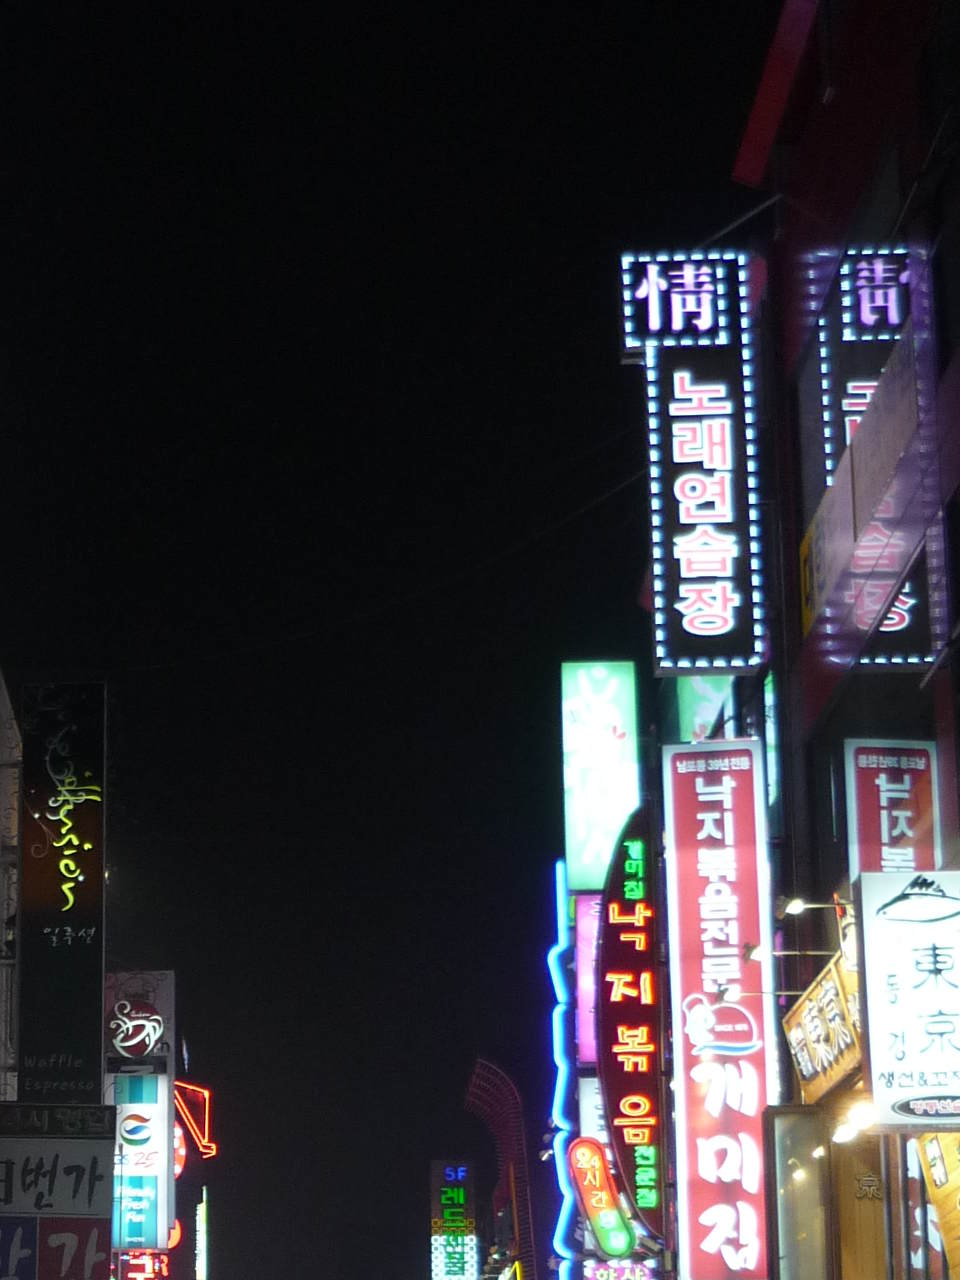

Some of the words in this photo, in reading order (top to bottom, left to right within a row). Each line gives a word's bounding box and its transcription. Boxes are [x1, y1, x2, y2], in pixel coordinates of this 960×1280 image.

[669, 368, 741, 636] 노래연습장
[606, 902, 657, 1144] 낙지볶음
[134, 1151, 157, 1167] 25
[690, 1060, 759, 1271] 개미집
